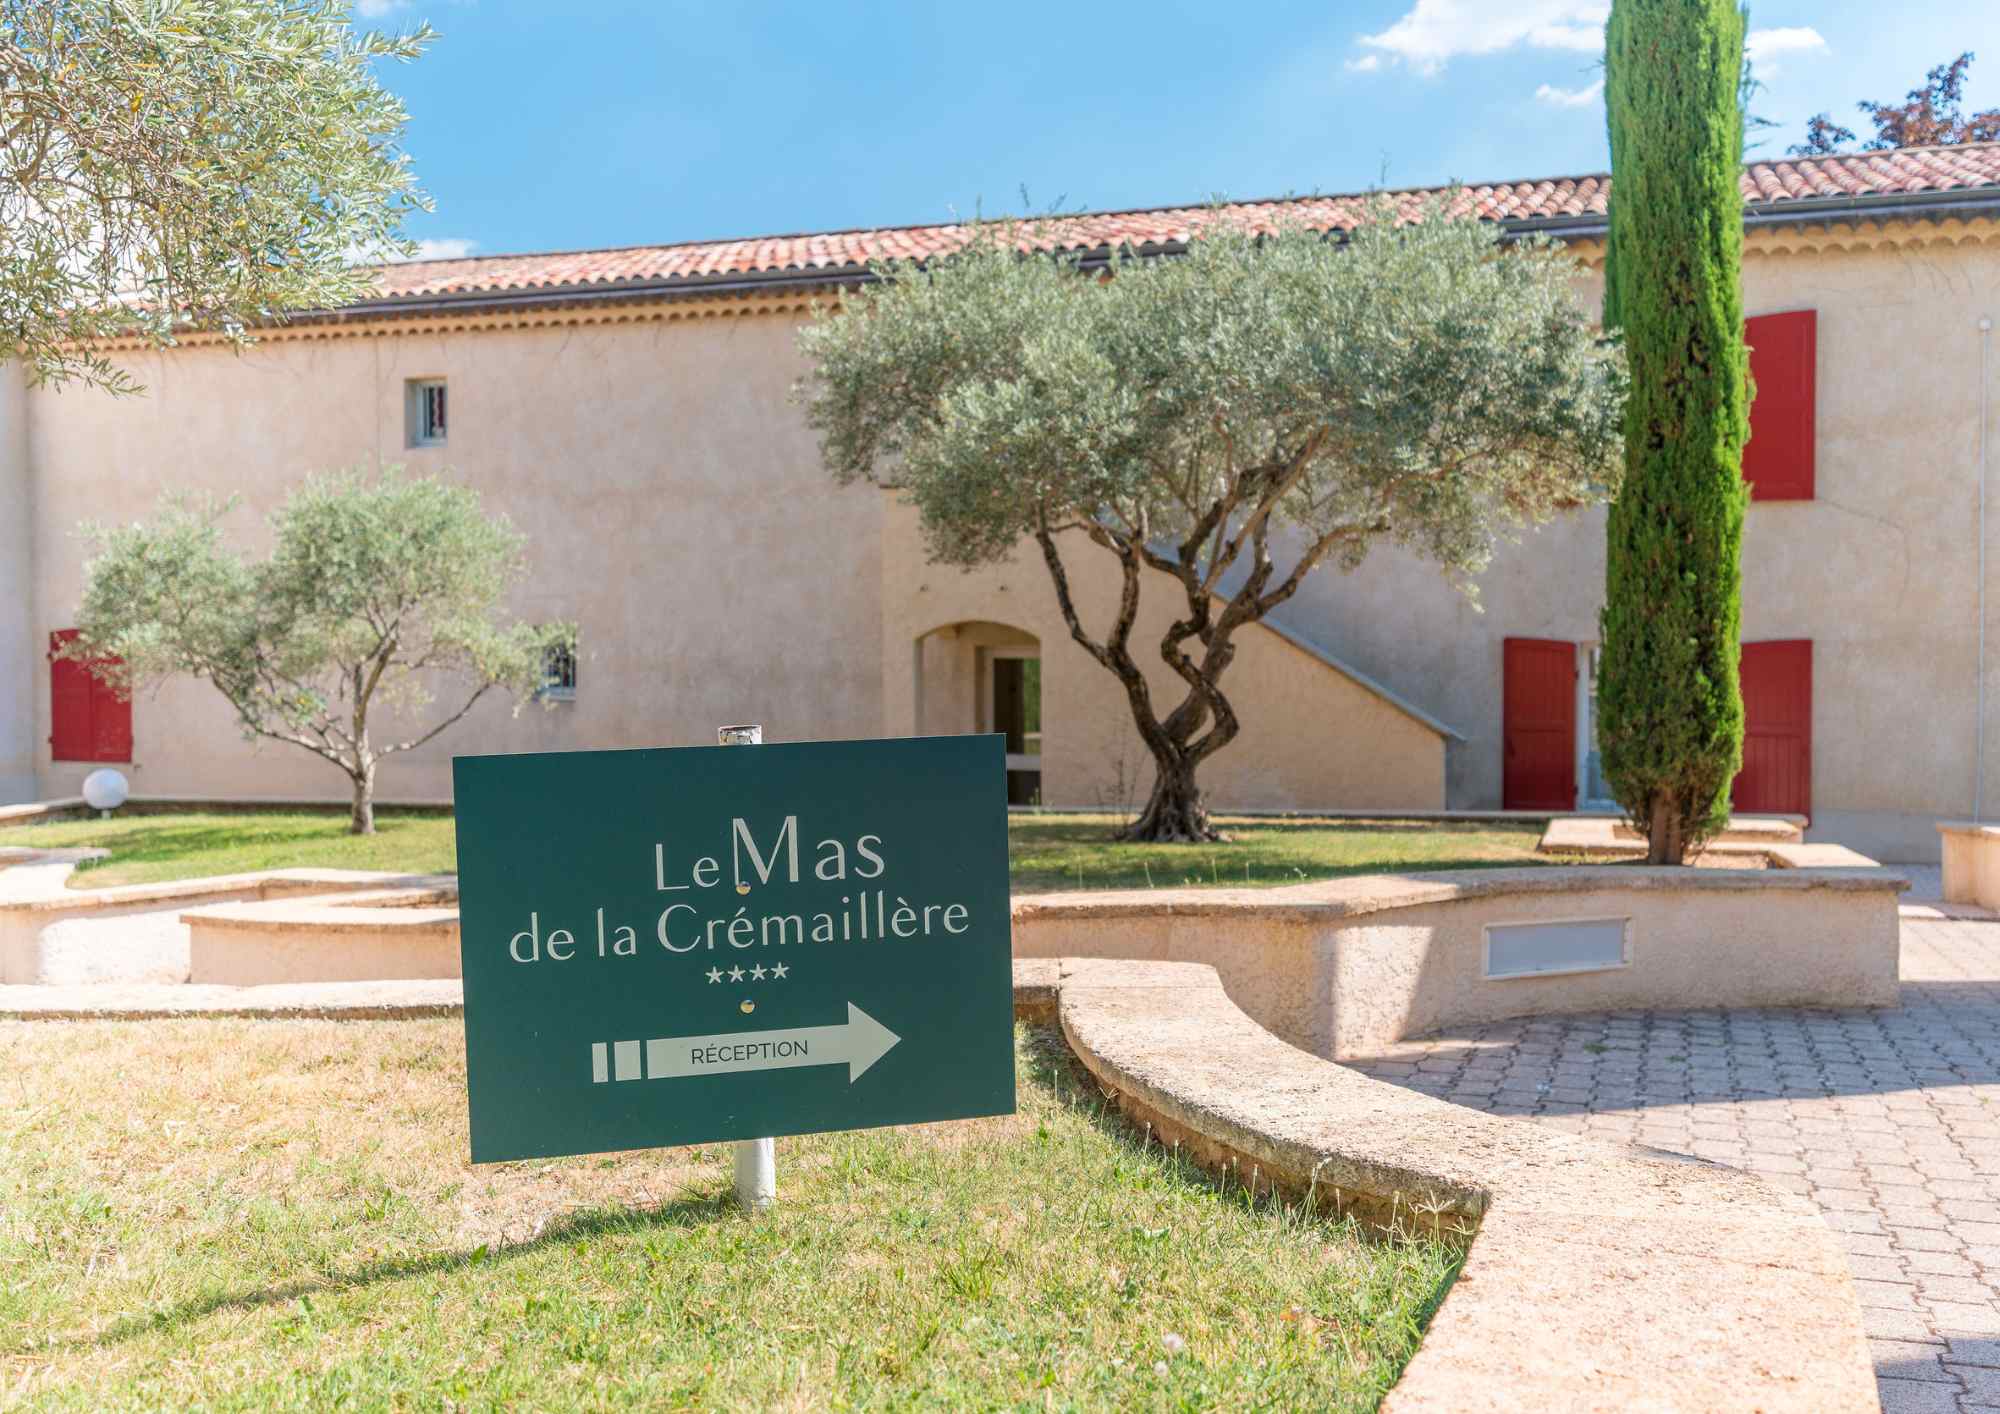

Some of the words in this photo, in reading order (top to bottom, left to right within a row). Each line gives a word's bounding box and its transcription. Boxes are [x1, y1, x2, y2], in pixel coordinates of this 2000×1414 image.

[656, 843, 721, 890] Le
[732, 815, 886, 886] Mas
[509, 911, 576, 963] de
[597, 907, 637, 957] la
[656, 891, 970, 953] Crémaillère
[690, 1039, 809, 1065] RÉCEPTION
